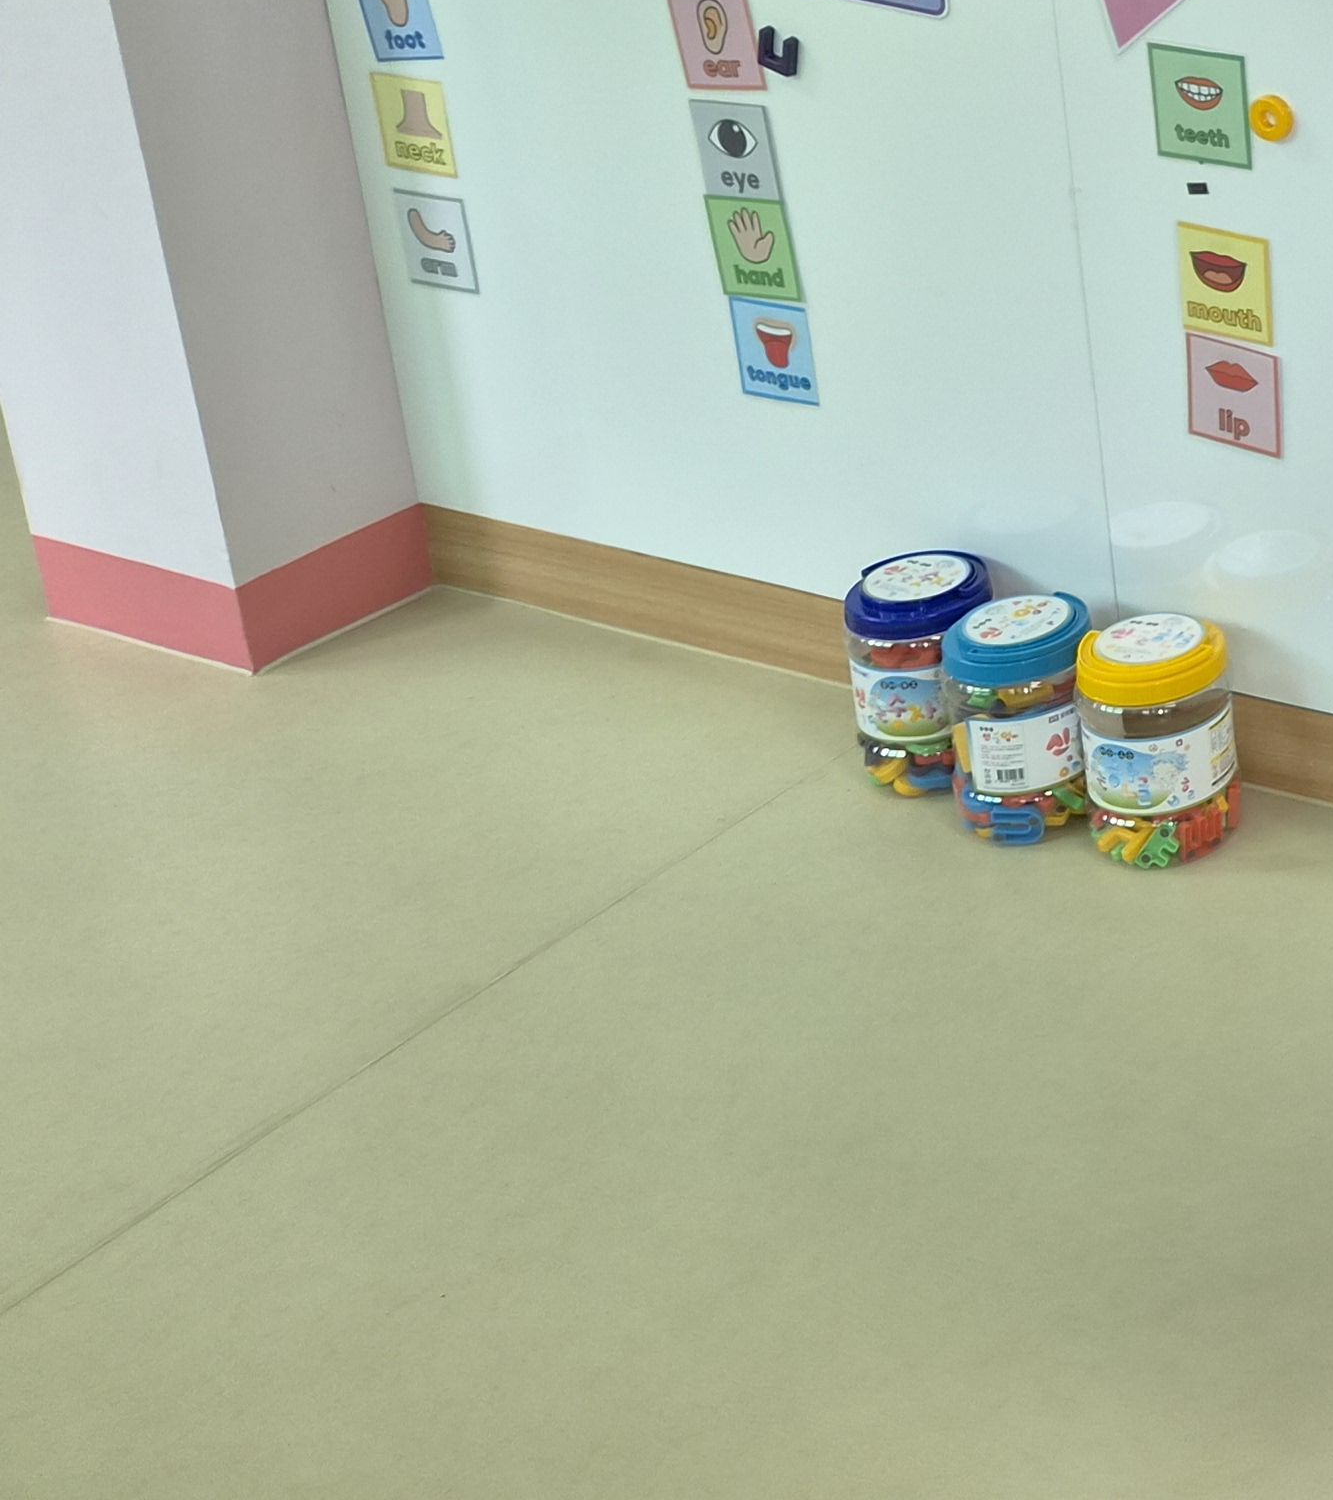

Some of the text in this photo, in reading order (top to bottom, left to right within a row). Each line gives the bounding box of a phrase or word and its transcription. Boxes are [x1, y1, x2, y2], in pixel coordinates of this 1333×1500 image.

[384, 29, 426, 50] foot
[703, 58, 741, 78] ear
[1174, 122, 1230, 149] teeth
[395, 141, 445, 165] neck
[721, 169, 760, 192] eye
[421, 256, 458, 277] arm
[734, 266, 784, 289] hand
[1188, 300, 1263, 331] mouth
[746, 366, 812, 392] tongue
[1218, 409, 1250, 440] lip
